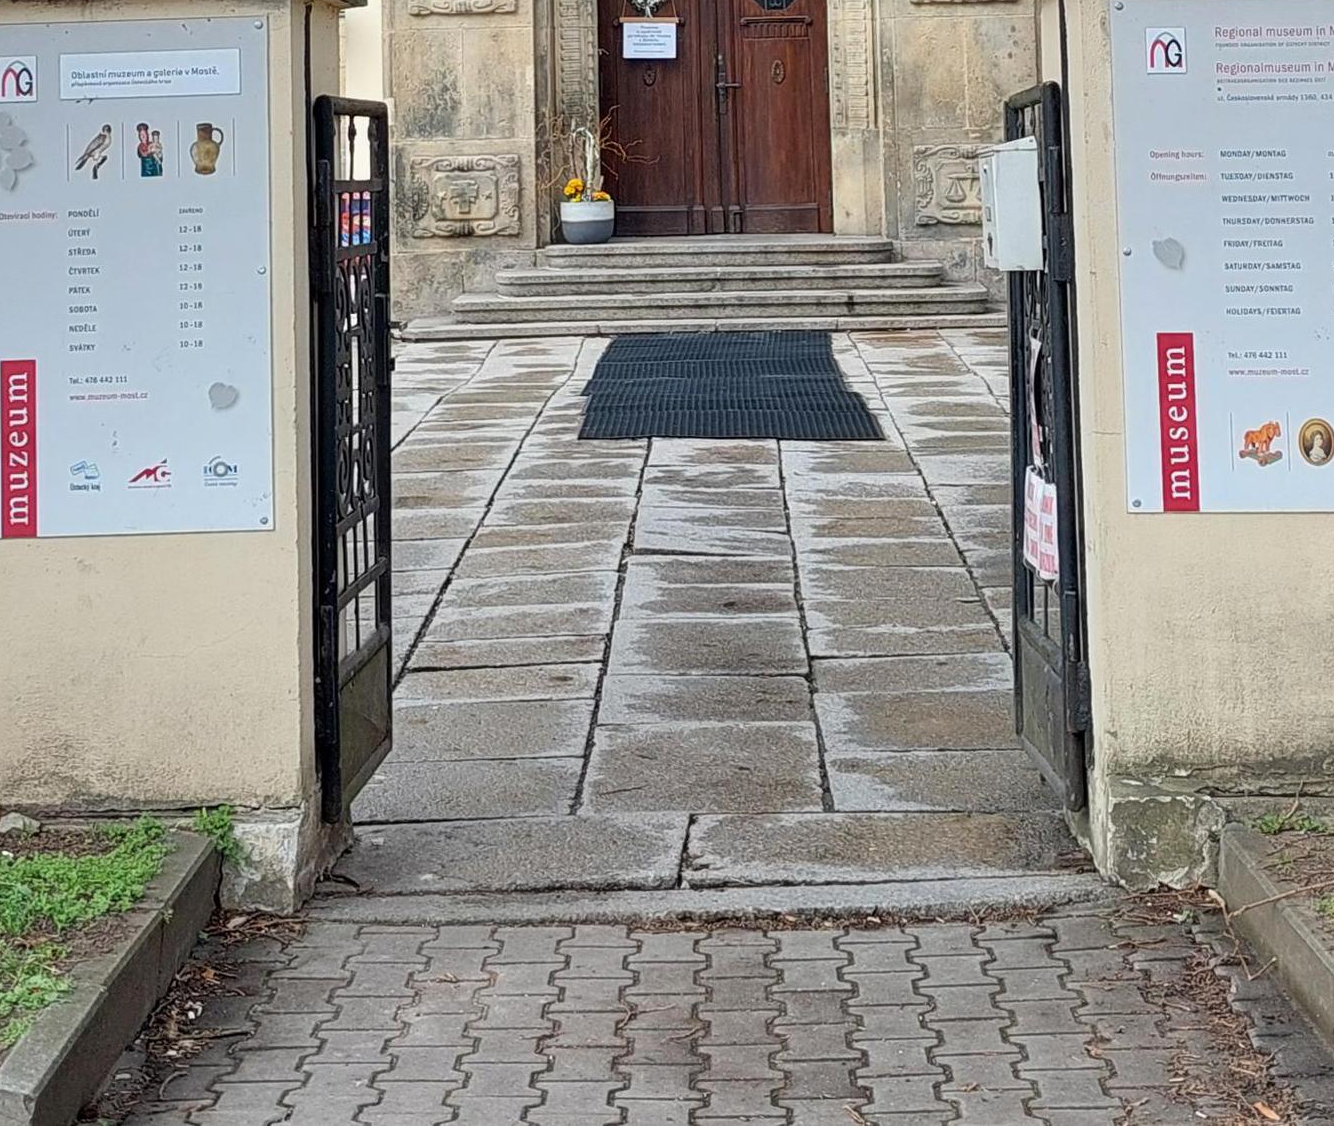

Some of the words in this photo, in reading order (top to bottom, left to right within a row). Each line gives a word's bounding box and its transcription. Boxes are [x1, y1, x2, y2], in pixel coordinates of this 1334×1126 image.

[1214, 26, 1262, 39] Regional
[1266, 27, 1313, 37] museum
[1316, 25, 1325, 36] in
[1216, 62, 1311, 75] Regionalmuseum
[1314, 61, 1324, 72] in
[71, 69, 107, 80] Oblastní
[108, 70, 145, 78] muzeum
[153, 68, 183, 79] galerie
[1149, 150, 1180, 160] Opening
[1220, 150, 1287, 159] MONDAY/MONTAG
[1220, 172, 1294, 181] TUESDAY/DIENSTAG
[1221, 194, 1310, 203] WEDNESDAY/MITTWOCH
[68, 208, 100, 218] PONDĚLÍ
[1222, 217, 1315, 226] THURSDAY/DONNERSTAG
[68, 227, 91, 237] ÚTERÝ
[1223, 240, 1283, 248] FRIDAY/FREITAG
[68, 247, 97, 256] STŘEDA
[68, 266, 100, 275] ČTVRTEK
[1224, 262, 1301, 271] SATURDAY/SAMSTAG
[68, 285, 91, 294] PÁTEK
[1225, 285, 1294, 294] SUNDAY/SONNTAG
[69, 305, 98, 313] SOBOTA
[1226, 307, 1301, 316] HOLIDAYS/FEIERTAG
[69, 323, 97, 332] NEDĚLE
[69, 343, 96, 352] SVÁTKY
[1258, 351, 1273, 359] 442
[1274, 351, 1288, 359] 111
[1228, 368, 1309, 376] www.muzeum-most.cz
[1168, 346, 1190, 500] museum
[8, 372, 29, 526] muzeum
